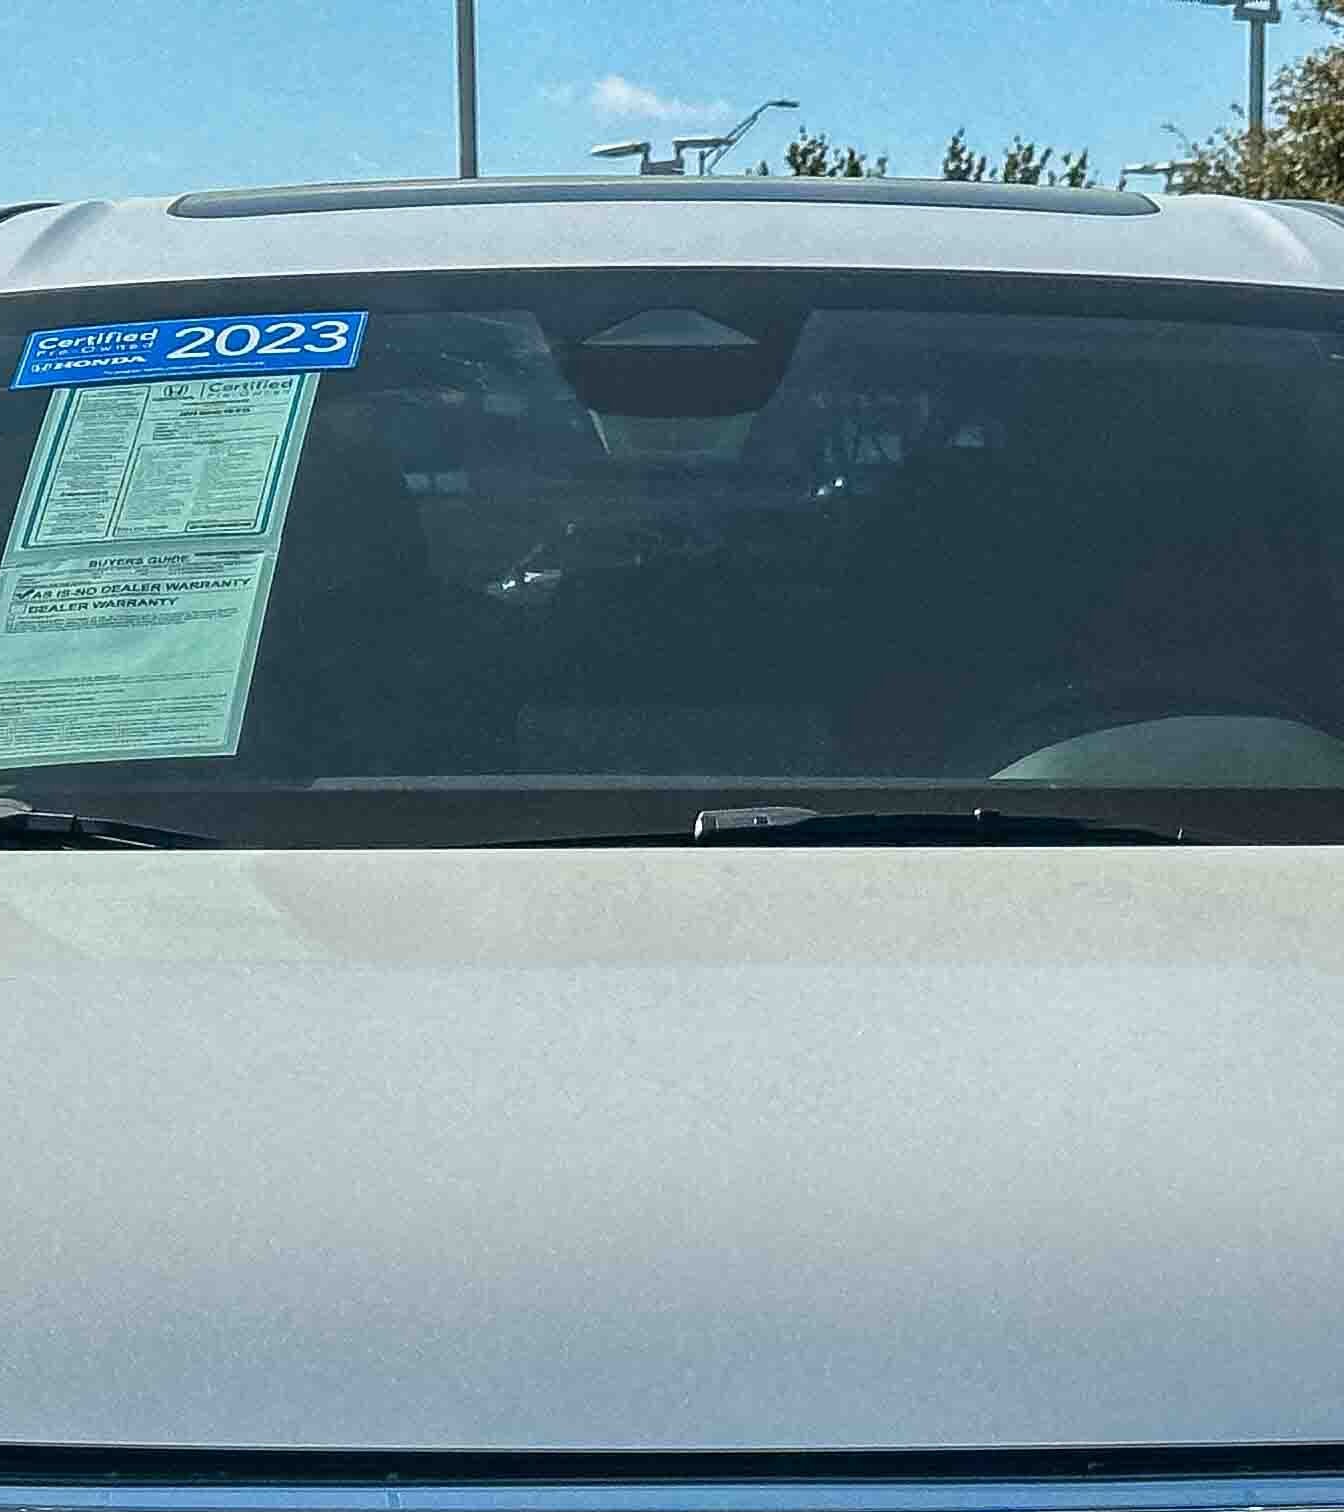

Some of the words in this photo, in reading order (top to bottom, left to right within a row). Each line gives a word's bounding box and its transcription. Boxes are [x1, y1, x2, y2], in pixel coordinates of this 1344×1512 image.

[38, 327, 159, 350] Certified
[167, 320, 351, 359] 2023
[54, 355, 146, 371] HONDA
[209, 378, 294, 393] Certified
[100, 582, 161, 594] DEALER
[165, 577, 253, 593] WARRANTY
[28, 601, 89, 614] DEALER
[93, 596, 180, 610] WARRANTY
